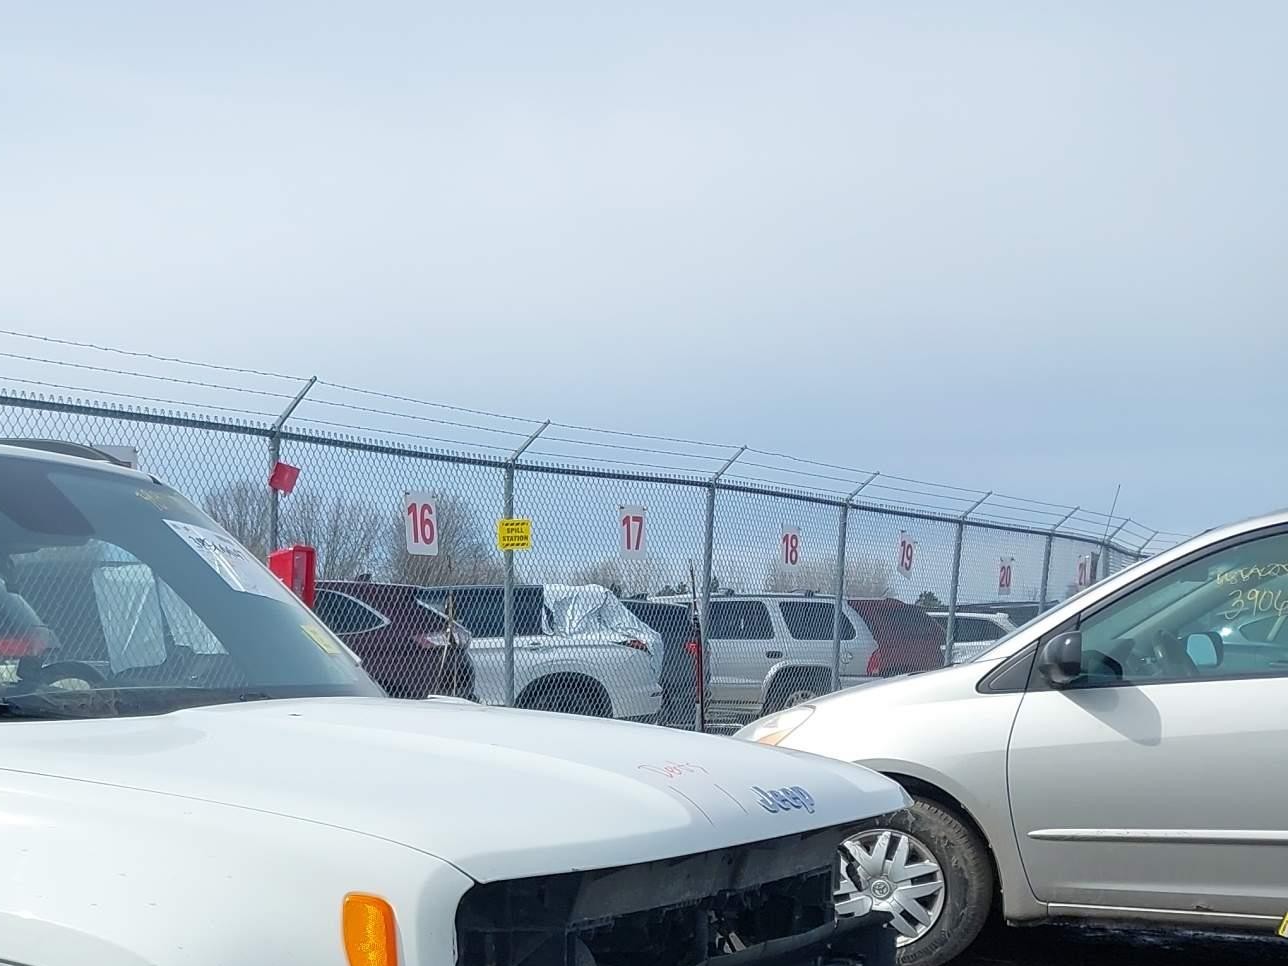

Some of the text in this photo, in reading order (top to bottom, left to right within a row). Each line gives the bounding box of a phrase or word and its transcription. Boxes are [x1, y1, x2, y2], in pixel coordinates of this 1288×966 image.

[407, 502, 435, 545] 16
[622, 515, 643, 551] 17
[782, 533, 799, 565] 18
[900, 540, 914, 571] 19
[999, 565, 1012, 588] 20
[751, 786, 816, 814] Jeep
